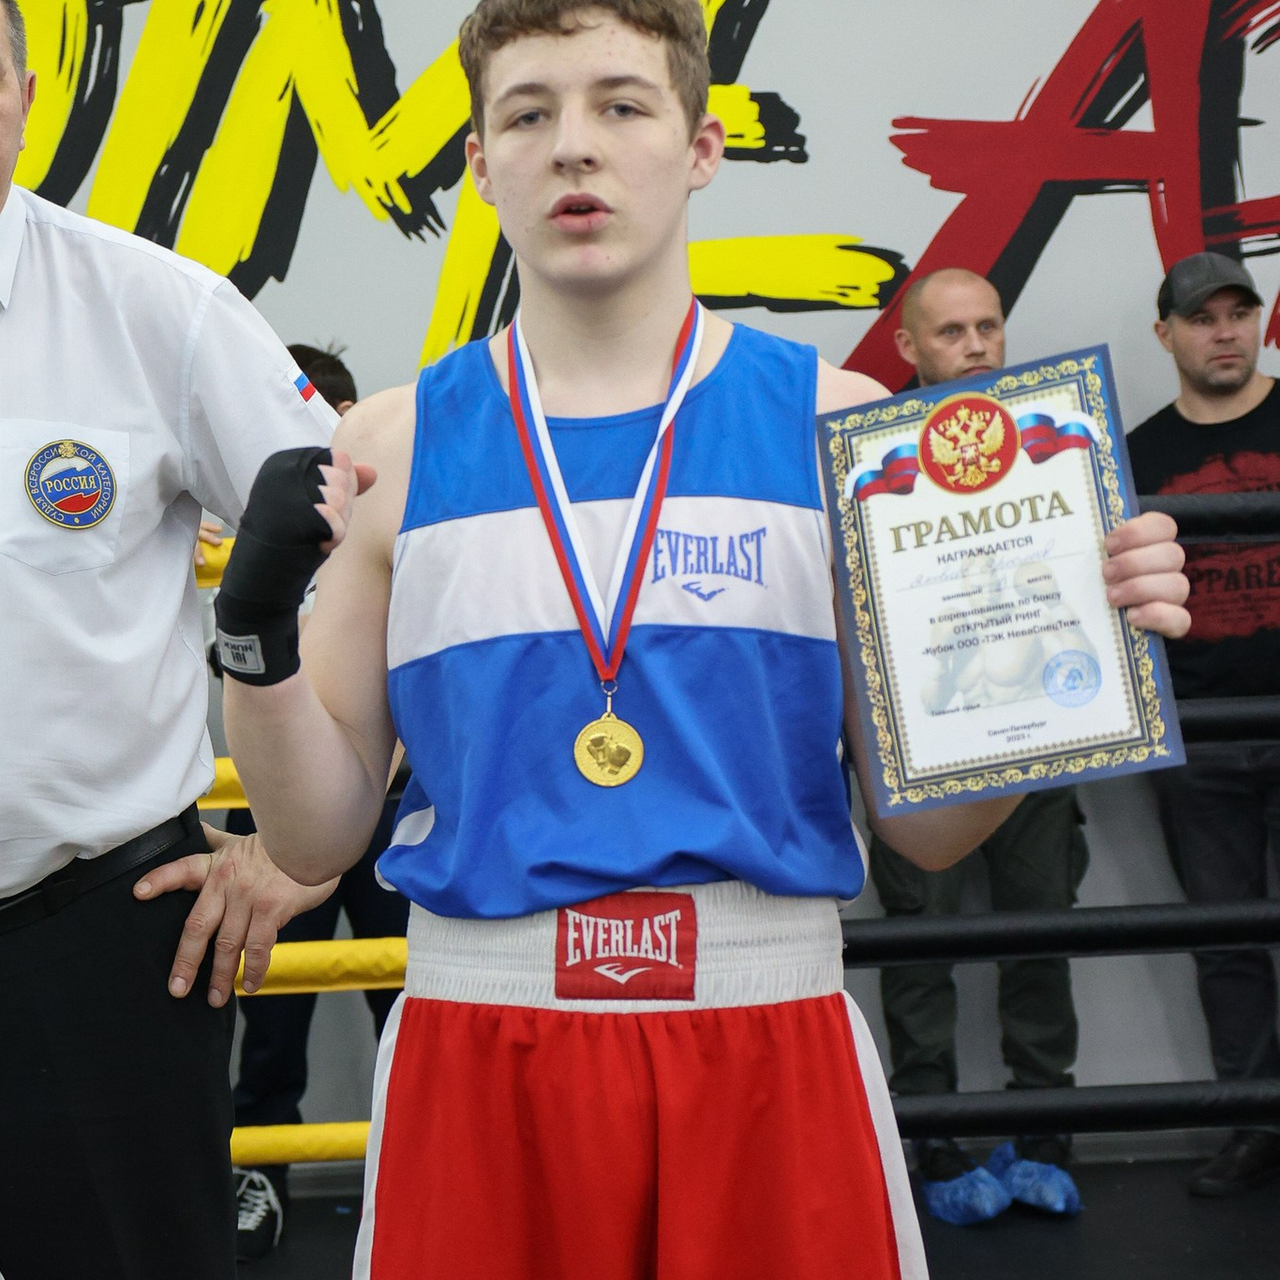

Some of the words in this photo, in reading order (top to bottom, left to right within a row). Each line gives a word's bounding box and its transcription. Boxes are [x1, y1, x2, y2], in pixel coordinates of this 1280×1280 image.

[35, 495, 65, 522] СУДЬЯ
[91, 462, 112, 519] КАТЕГОРИИ
[45, 475, 97, 494] РОССИЯ
[889, 490, 1074, 553] ГРАМОТА
[651, 526, 767, 586] EVERLAST
[937, 535, 1033, 564] НАГРАЖДАЕТСЯ
[1027, 574, 1052, 584] место
[929, 617, 936, 625] в
[938, 602, 1015, 624] соревнованиях
[1018, 596, 1031, 607] по
[1033, 590, 1062, 606] боксу
[953, 614, 1013, 635] ОТКРЫТЫЙ
[1015, 609, 1042, 623] РИНГ
[957, 637, 980, 649] ООО
[987, 720, 1047, 737] Санкт-Петербург
[565, 908, 681, 967] EVERLAST
